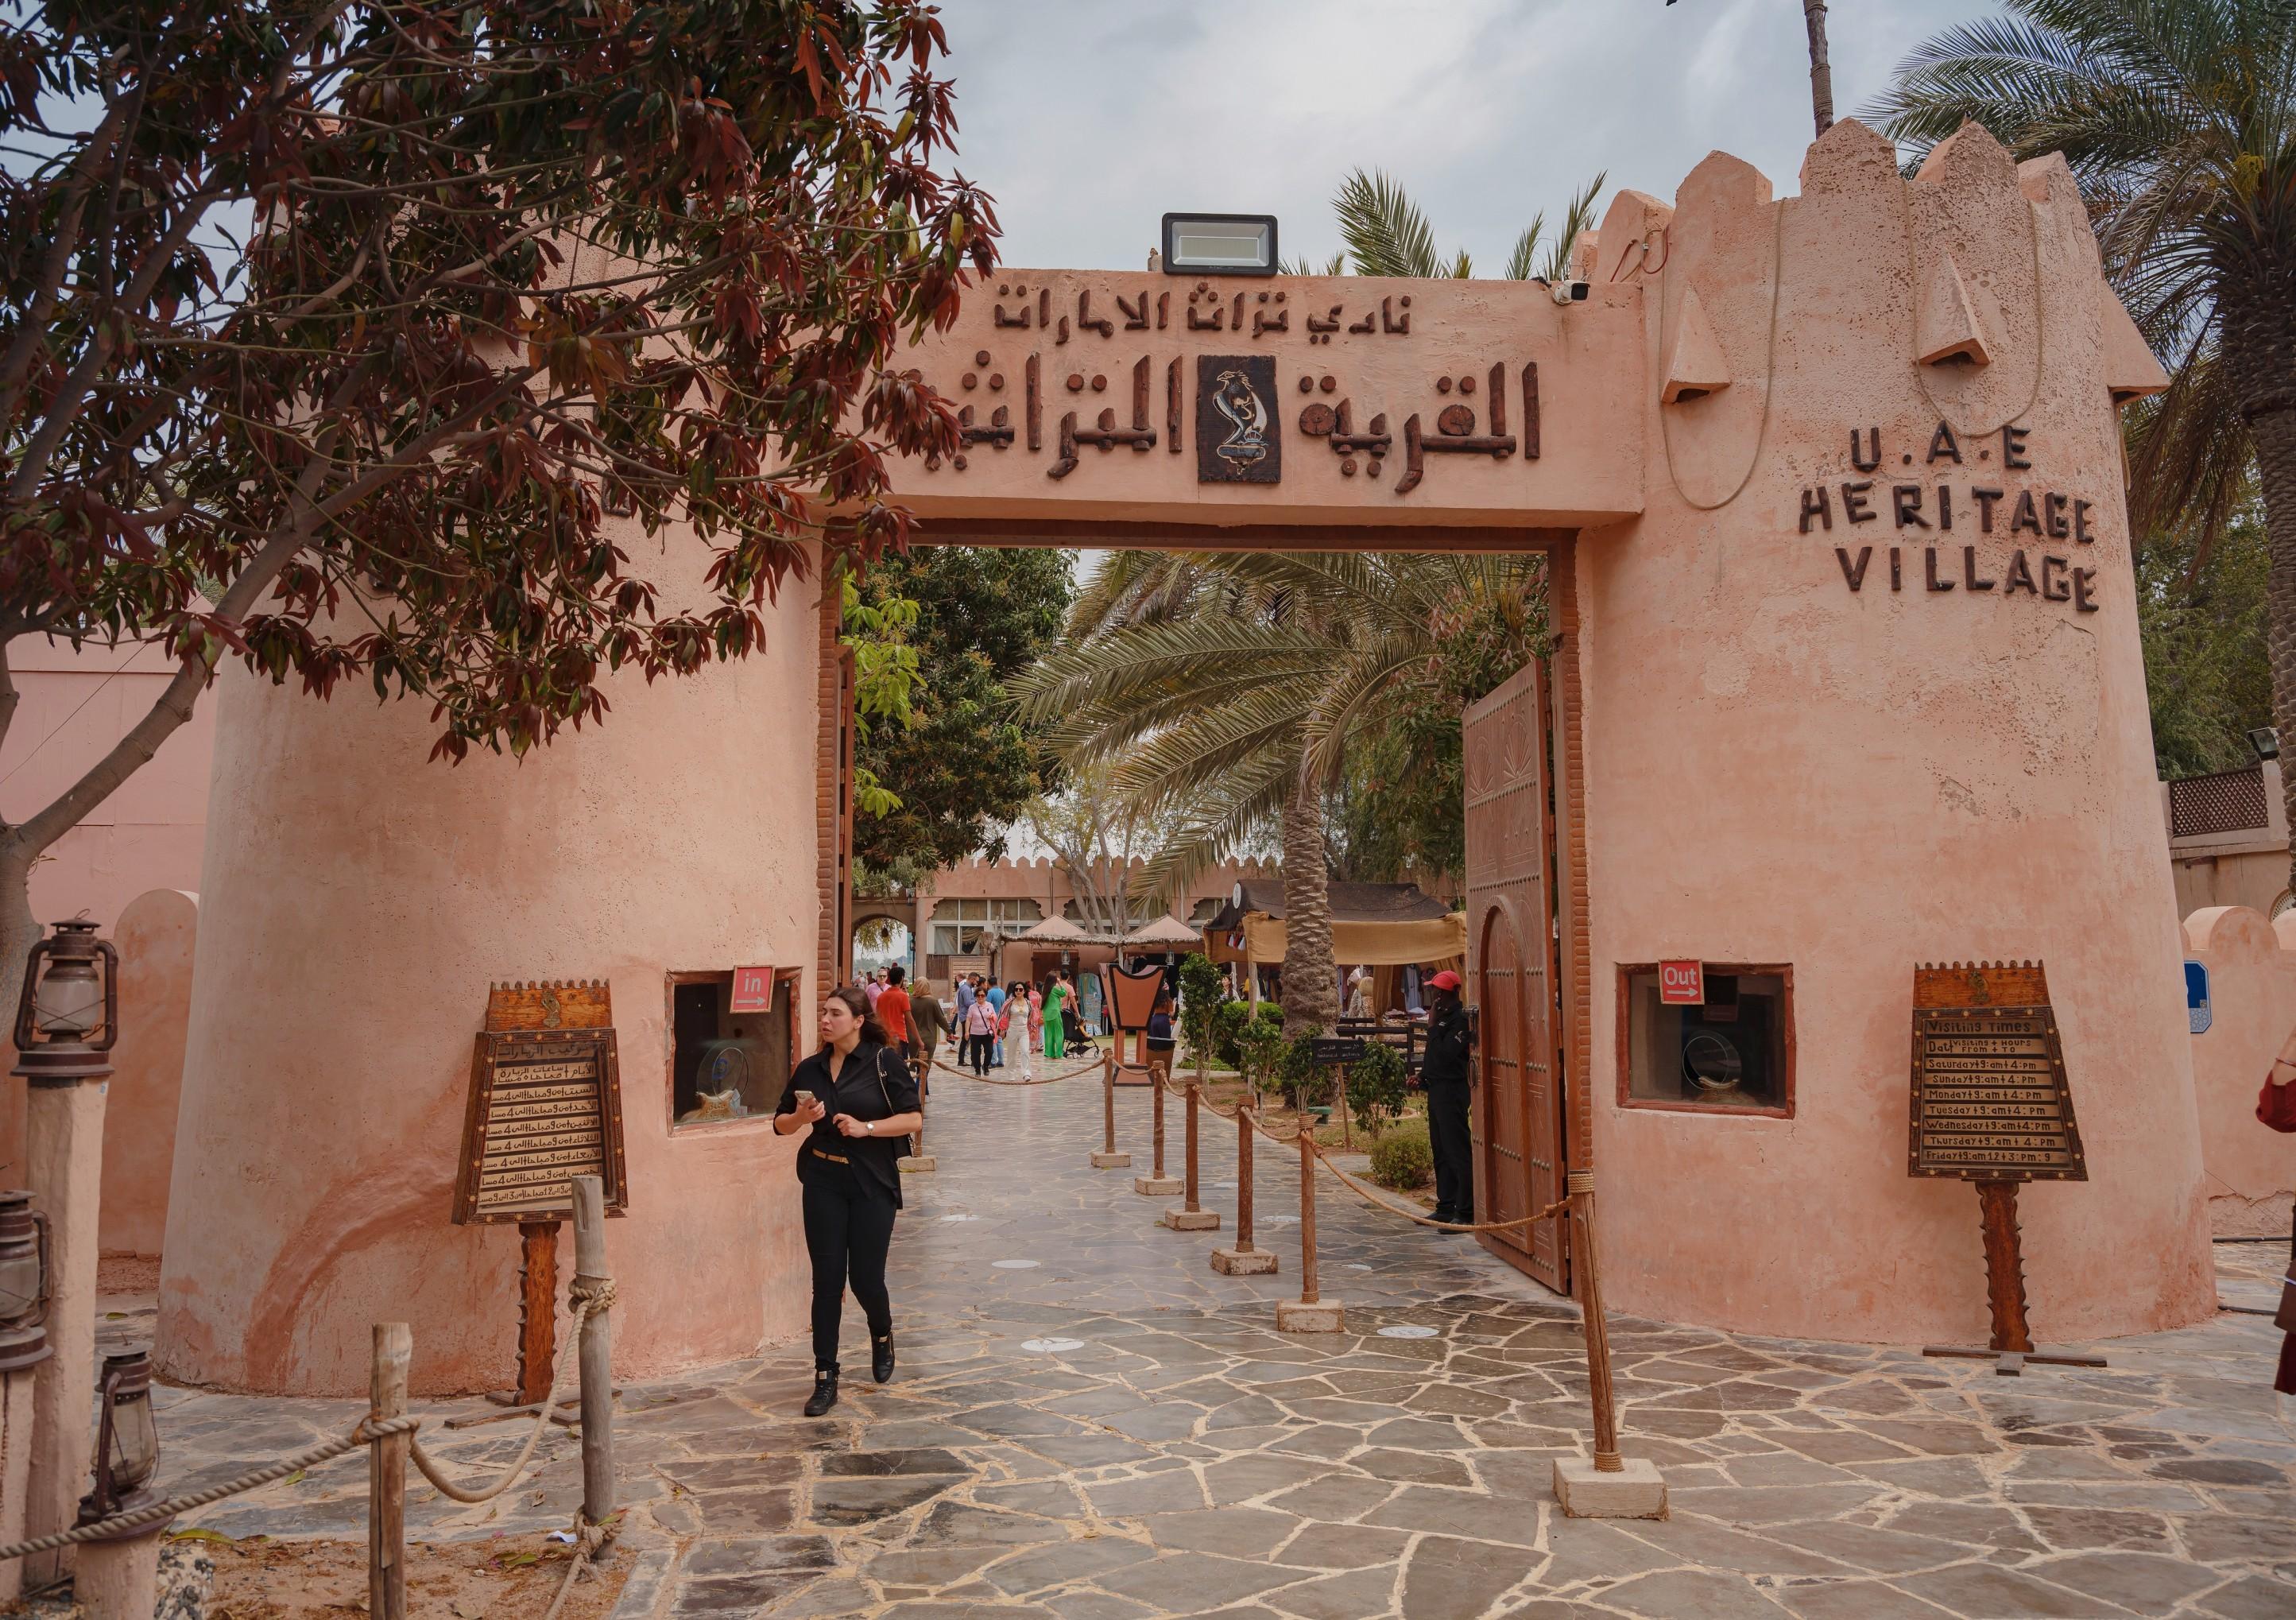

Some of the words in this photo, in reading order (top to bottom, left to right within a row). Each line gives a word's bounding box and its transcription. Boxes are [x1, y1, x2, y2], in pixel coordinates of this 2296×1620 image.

[1187, 281, 1288, 338] تراث
[1307, 295, 1410, 344] نادي
[885, 351, 1183, 480] التراثي
[1299, 361, 1540, 494] القرية
[1798, 480, 2096, 544] HERITAGE
[1834, 545, 2100, 612] VILLAGE
[744, 971, 761, 993] in
[1664, 967, 1698, 986] Out
[1928, 1021, 1981, 1033] Visiting
[1988, 1022, 2031, 1033] Times
[1929, 1059, 1975, 1069] Saturday
[1932, 1075, 1969, 1083] Sunday
[1929, 1090, 1965, 1099] Monday
[1929, 1106, 1971, 1115] Tuesday
[1926, 1121, 1983, 1130] Wednesday
[1930, 1136, 1978, 1145] Thursday
[1926, 1150, 1959, 1161] Friday
